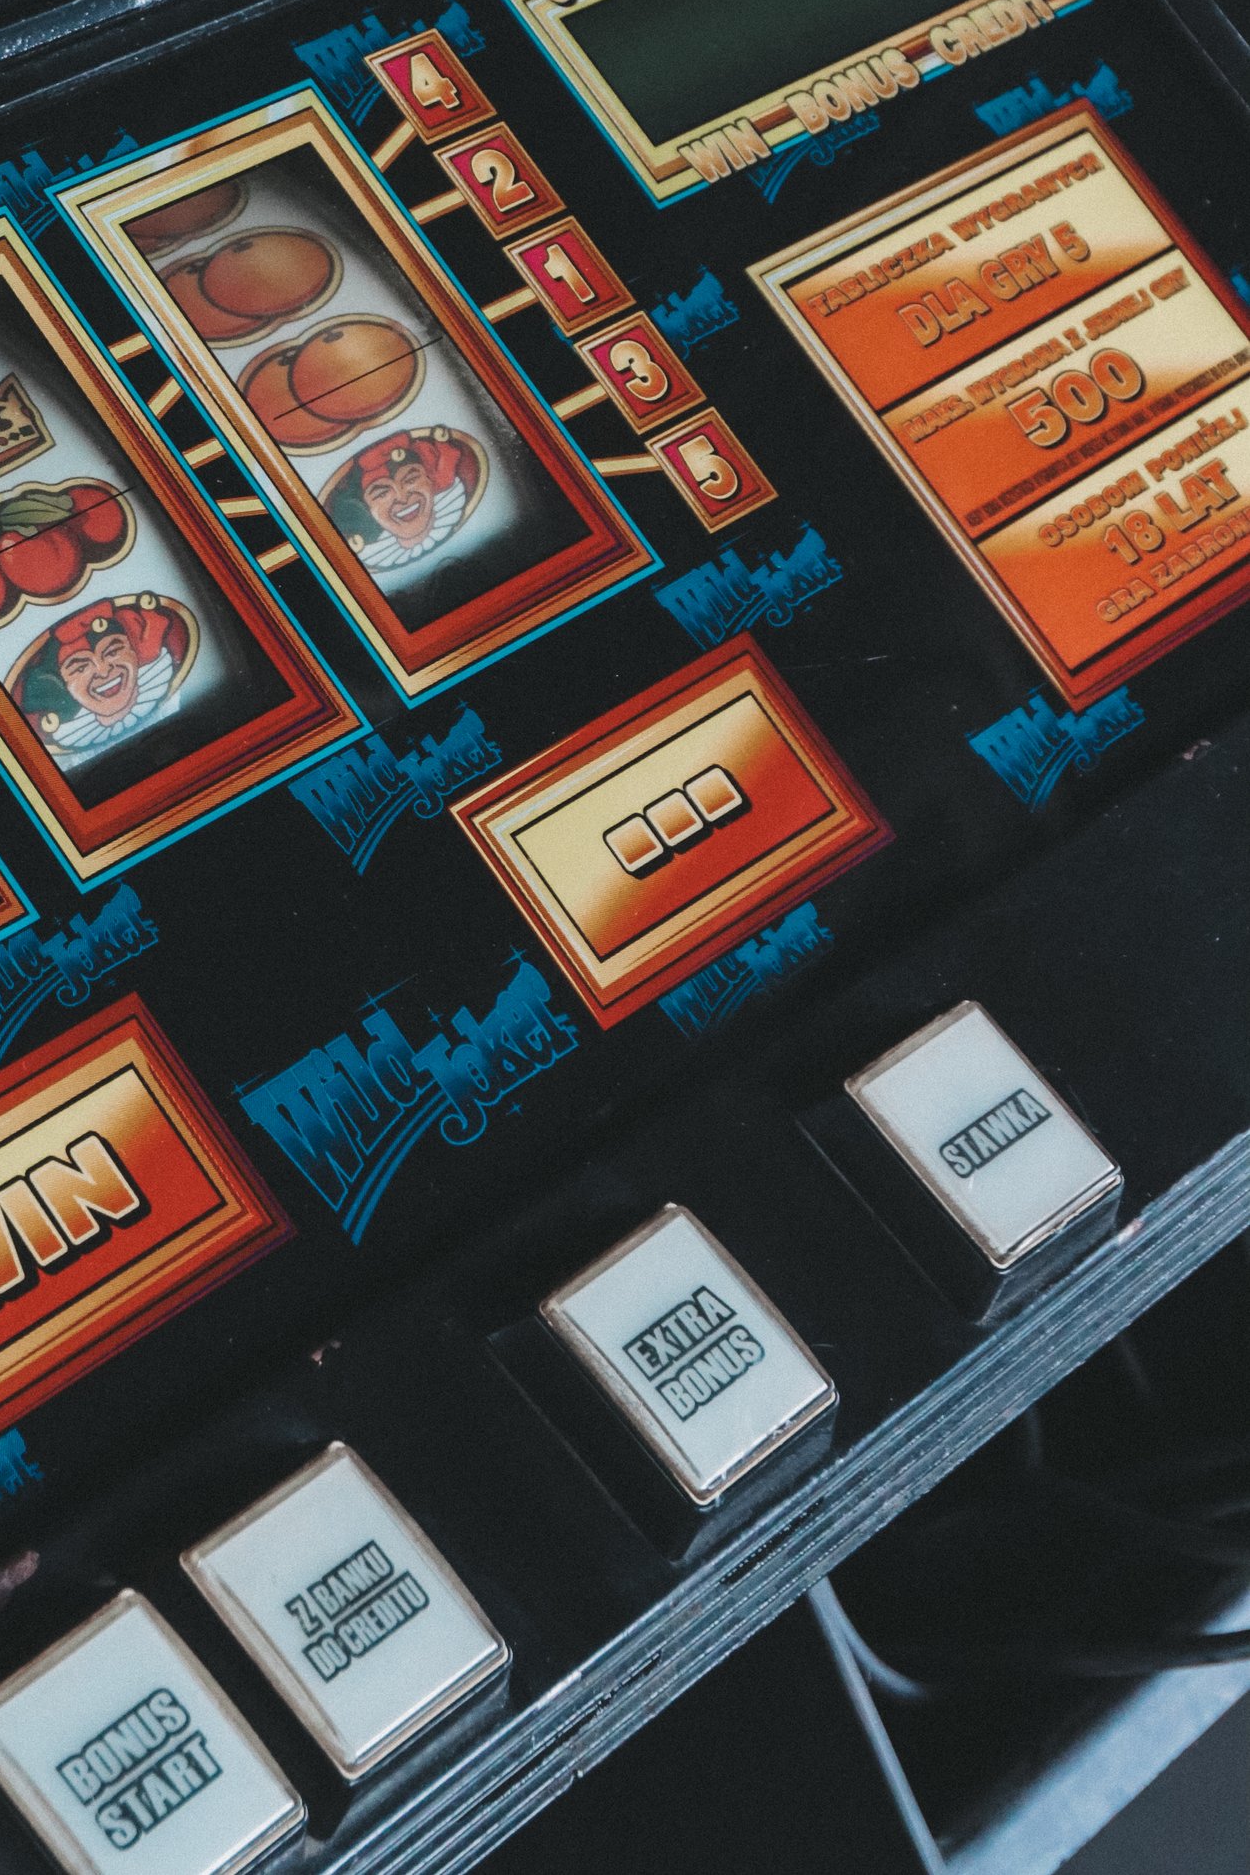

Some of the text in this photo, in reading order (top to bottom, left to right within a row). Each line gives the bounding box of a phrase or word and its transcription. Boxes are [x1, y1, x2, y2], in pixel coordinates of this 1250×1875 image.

[410, 52, 461, 110] 4
[677, 116, 772, 183] WIN
[784, 46, 921, 135] BONUS
[470, 148, 537, 213] 2
[807, 151, 1106, 318] TABLICZKA WYGRANYCH
[543, 243, 596, 304] 1
[897, 219, 1091, 349] DLA GRY 5
[608, 338, 671, 402] 3
[901, 394, 977, 444] MAKS.
[1062, 327, 1088, 352] Z
[1004, 347, 1147, 450] 500
[676, 438, 739, 501] 5
[1037, 469, 1150, 548] OSOBOM
[1144, 406, 1249, 483] PONIŻEJ
[1103, 457, 1242, 567] 18 LAT
[654, 527, 844, 651] Wild Joker
[1096, 578, 1157, 624] GRA
[287, 707, 503, 856] Wild Joker
[968, 694, 1068, 804] Wild
[40, 882, 159, 1008] Joker
[239, 961, 579, 1212] Wild Joker
[939, 1087, 1053, 1179] STAWKA
[622, 1285, 738, 1378] EXTRA
[656, 1323, 765, 1422] BONUS
[284, 1539, 395, 1637] Z BANKU
[302, 1571, 431, 1684] DO CREDITU
[55, 1687, 191, 1806] BONUS
[93, 1731, 224, 1852] START
